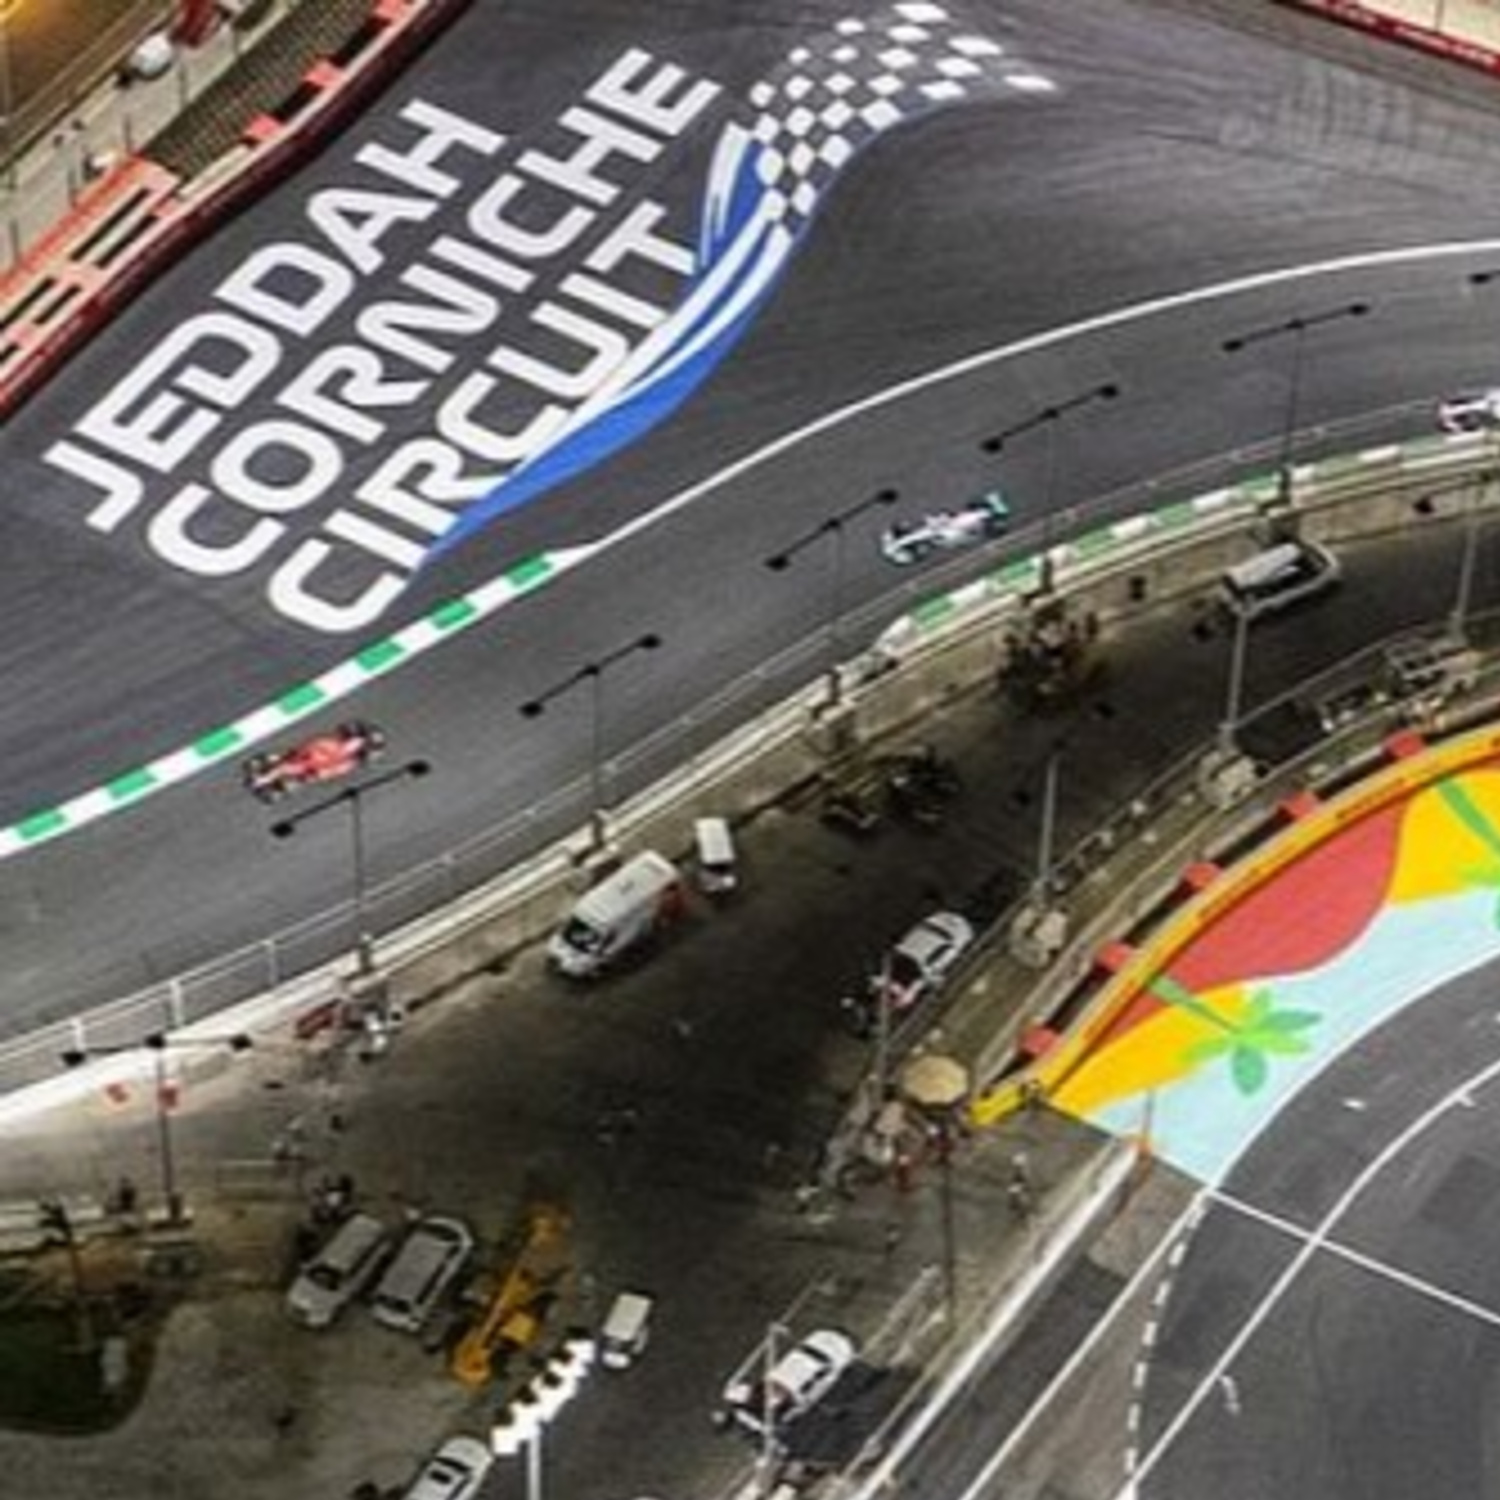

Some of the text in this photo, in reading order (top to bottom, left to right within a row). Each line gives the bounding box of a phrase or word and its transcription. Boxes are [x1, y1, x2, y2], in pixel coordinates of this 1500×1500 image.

[42, 98, 506, 533] JEDDAH
[147, 48, 722, 575] CORNICHE
[267, 200, 698, 633] CIRCUIT
